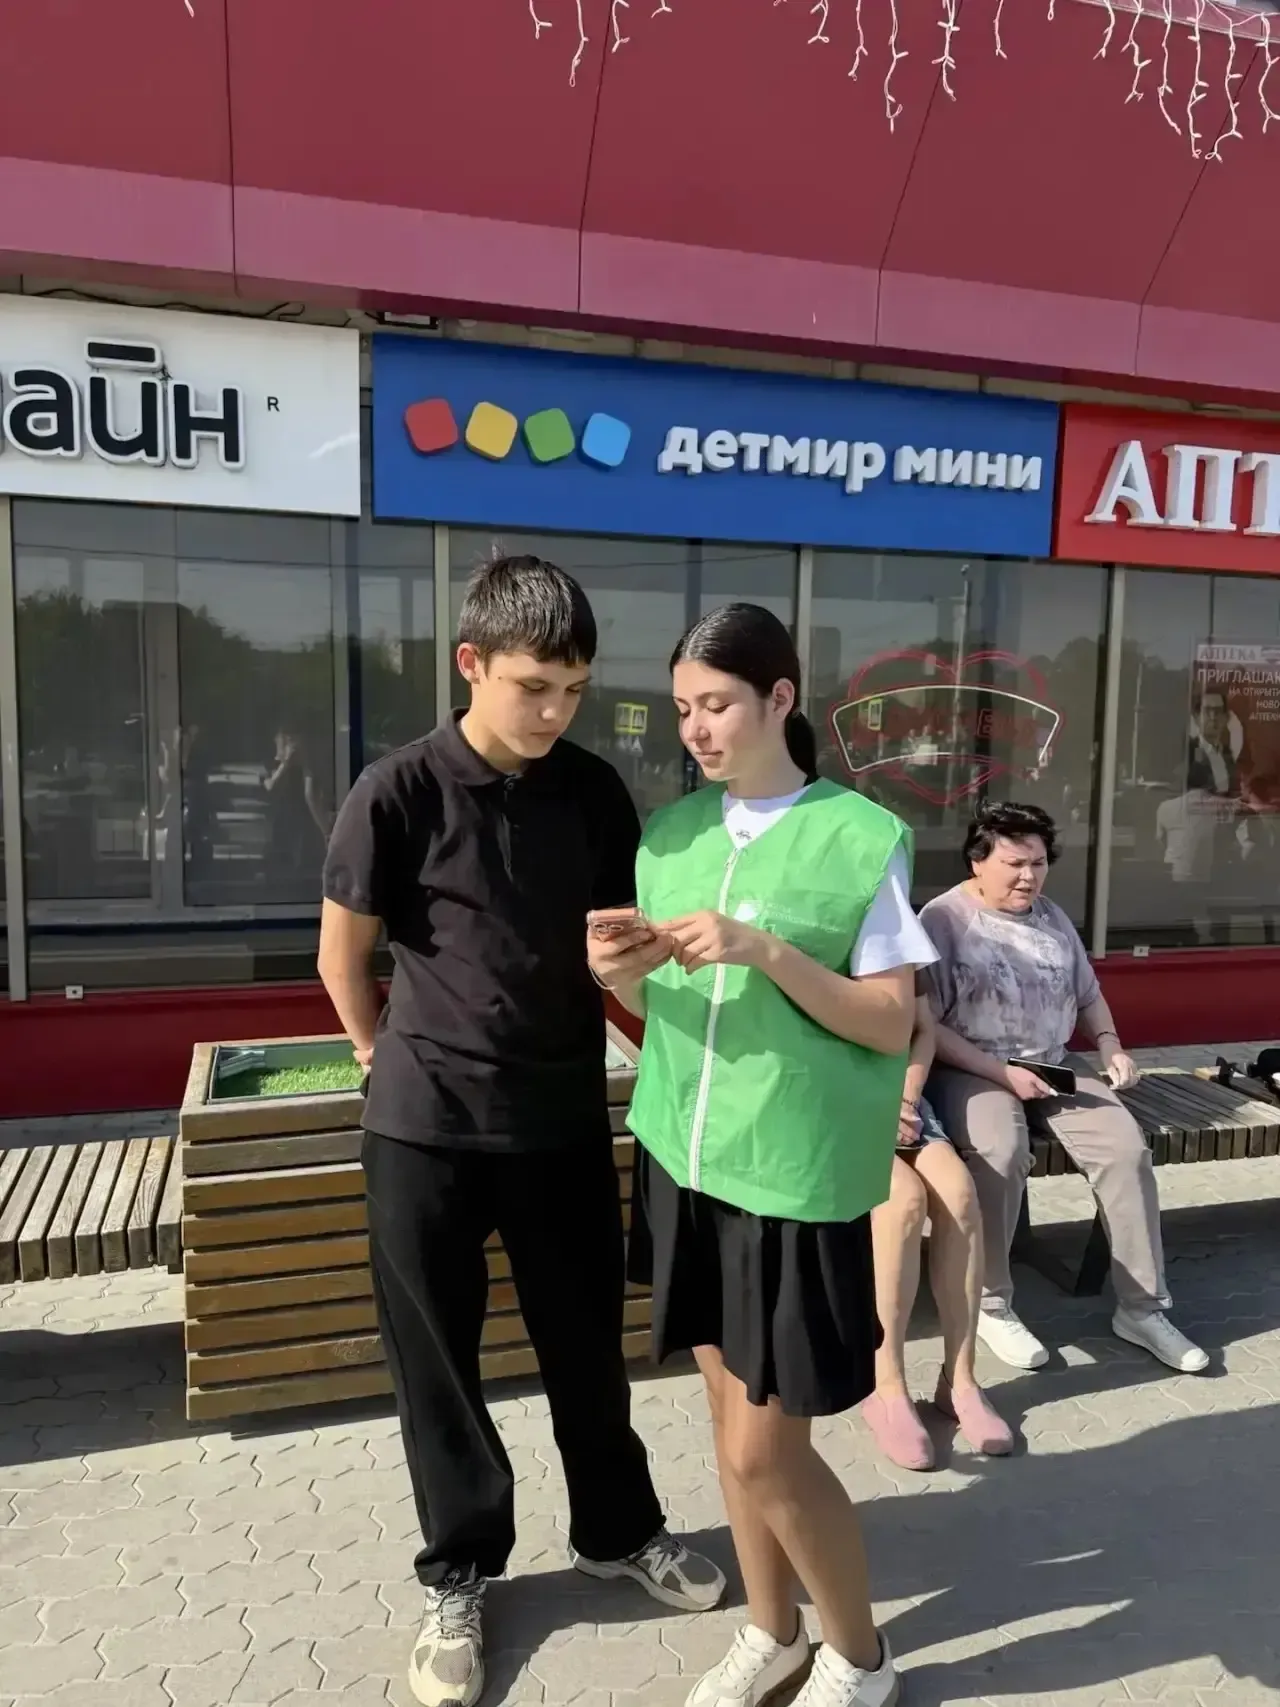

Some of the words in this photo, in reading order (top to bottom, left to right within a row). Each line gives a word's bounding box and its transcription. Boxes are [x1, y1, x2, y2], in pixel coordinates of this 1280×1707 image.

[0, 338, 245, 467] айн
[266, 396, 280, 412] R
[658, 425, 886, 494] детмир
[893, 444, 1043, 492] мини
[1084, 440, 1280, 537] АПТ
[1200, 646, 1256, 661] АПТЕКА
